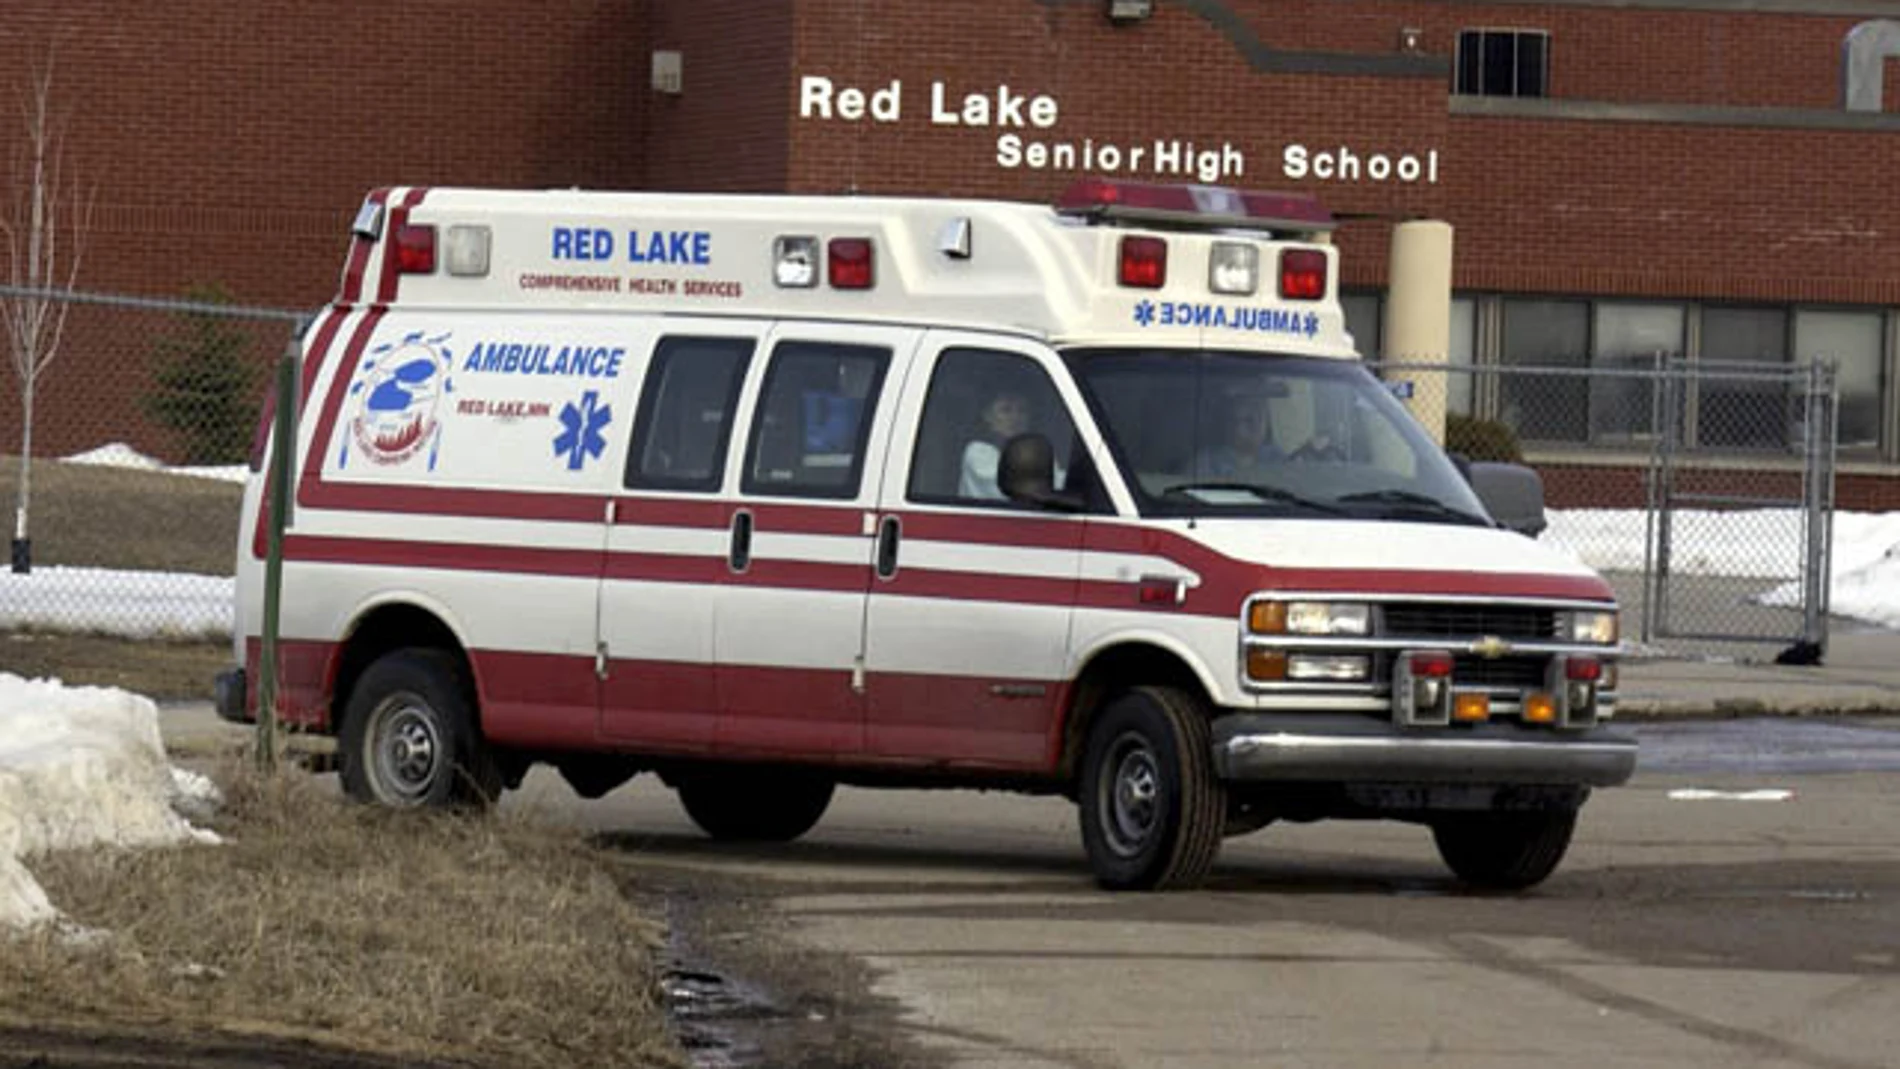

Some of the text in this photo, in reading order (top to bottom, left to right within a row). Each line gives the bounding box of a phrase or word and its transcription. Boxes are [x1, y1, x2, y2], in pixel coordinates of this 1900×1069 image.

[799, 76, 1058, 128] Red Lake
[997, 135, 1439, 183] Senior High School
[552, 227, 711, 264] RED LAKE
[519, 273, 742, 297] COMPREHENSIVE HEALTH SERVICES
[463, 342, 626, 377] AMBULANCE
[457, 400, 486, 414] RED
